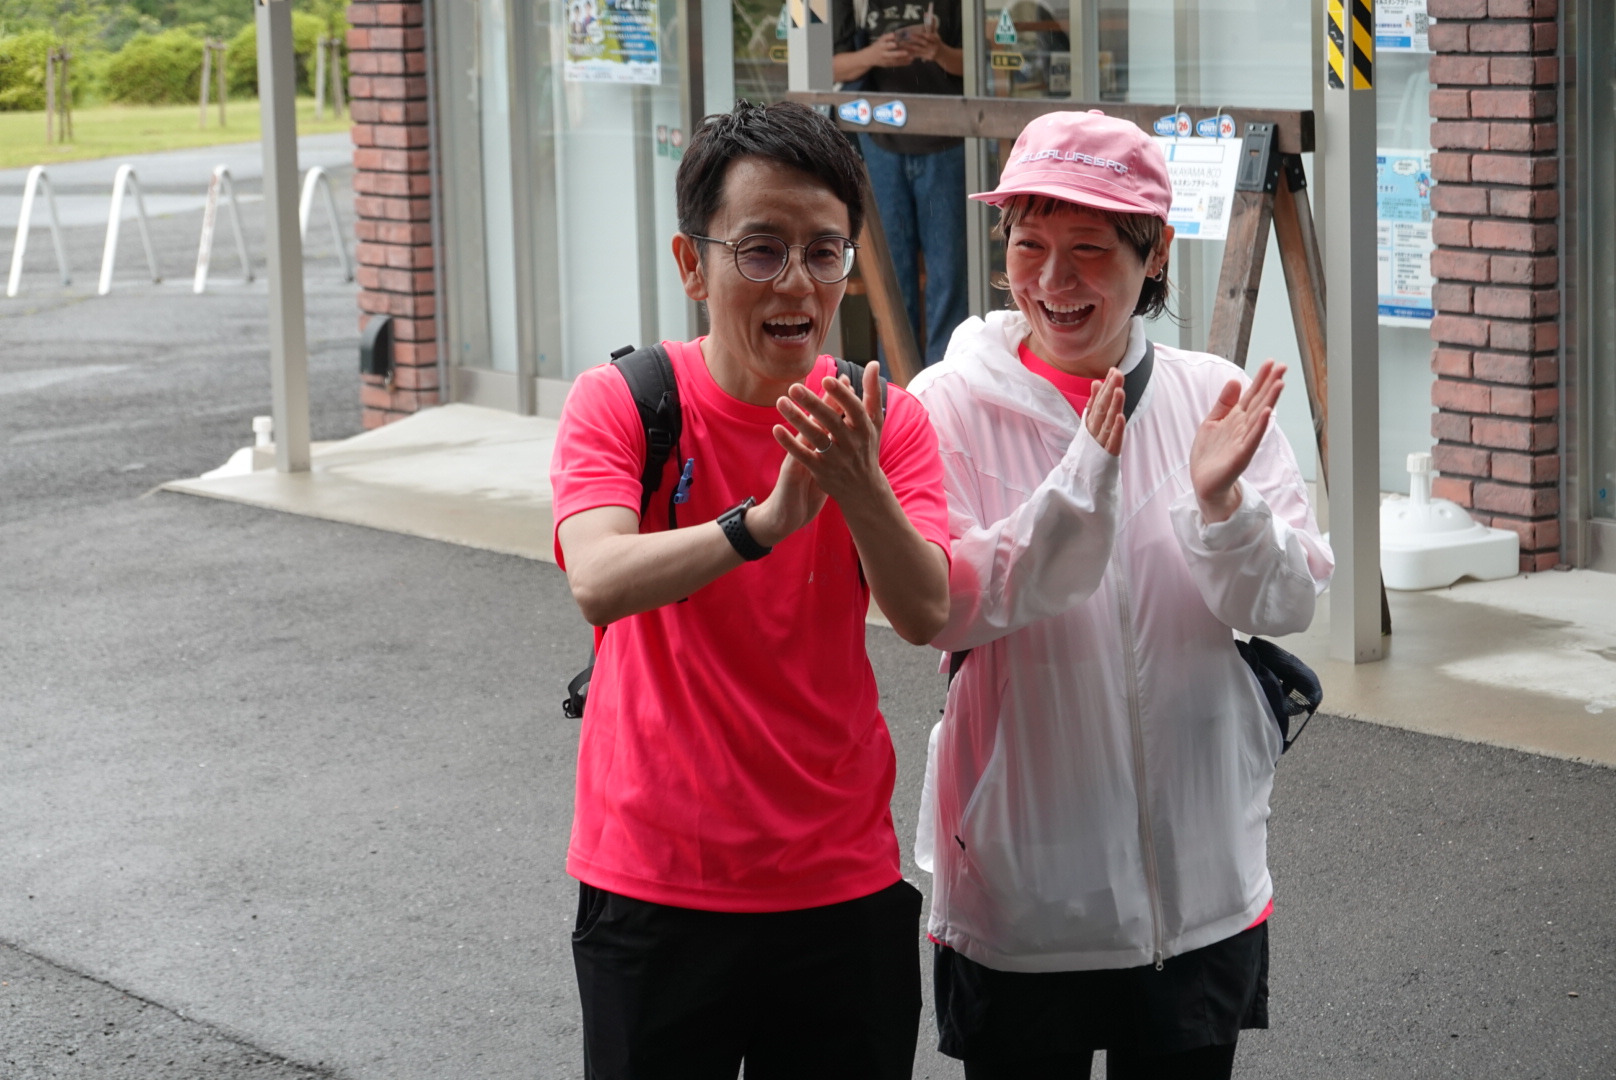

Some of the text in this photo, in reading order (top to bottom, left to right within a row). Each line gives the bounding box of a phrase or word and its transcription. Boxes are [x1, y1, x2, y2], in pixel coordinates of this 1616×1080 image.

[1178, 121, 1189, 132] 26
[1221, 122, 1232, 134] 26
[1030, 149, 1064, 161] LOCAL
[1064, 151, 1093, 165] LIFE
[1093, 156, 1106, 167] IS
[1167, 167, 1205, 176] AKAYAMA
